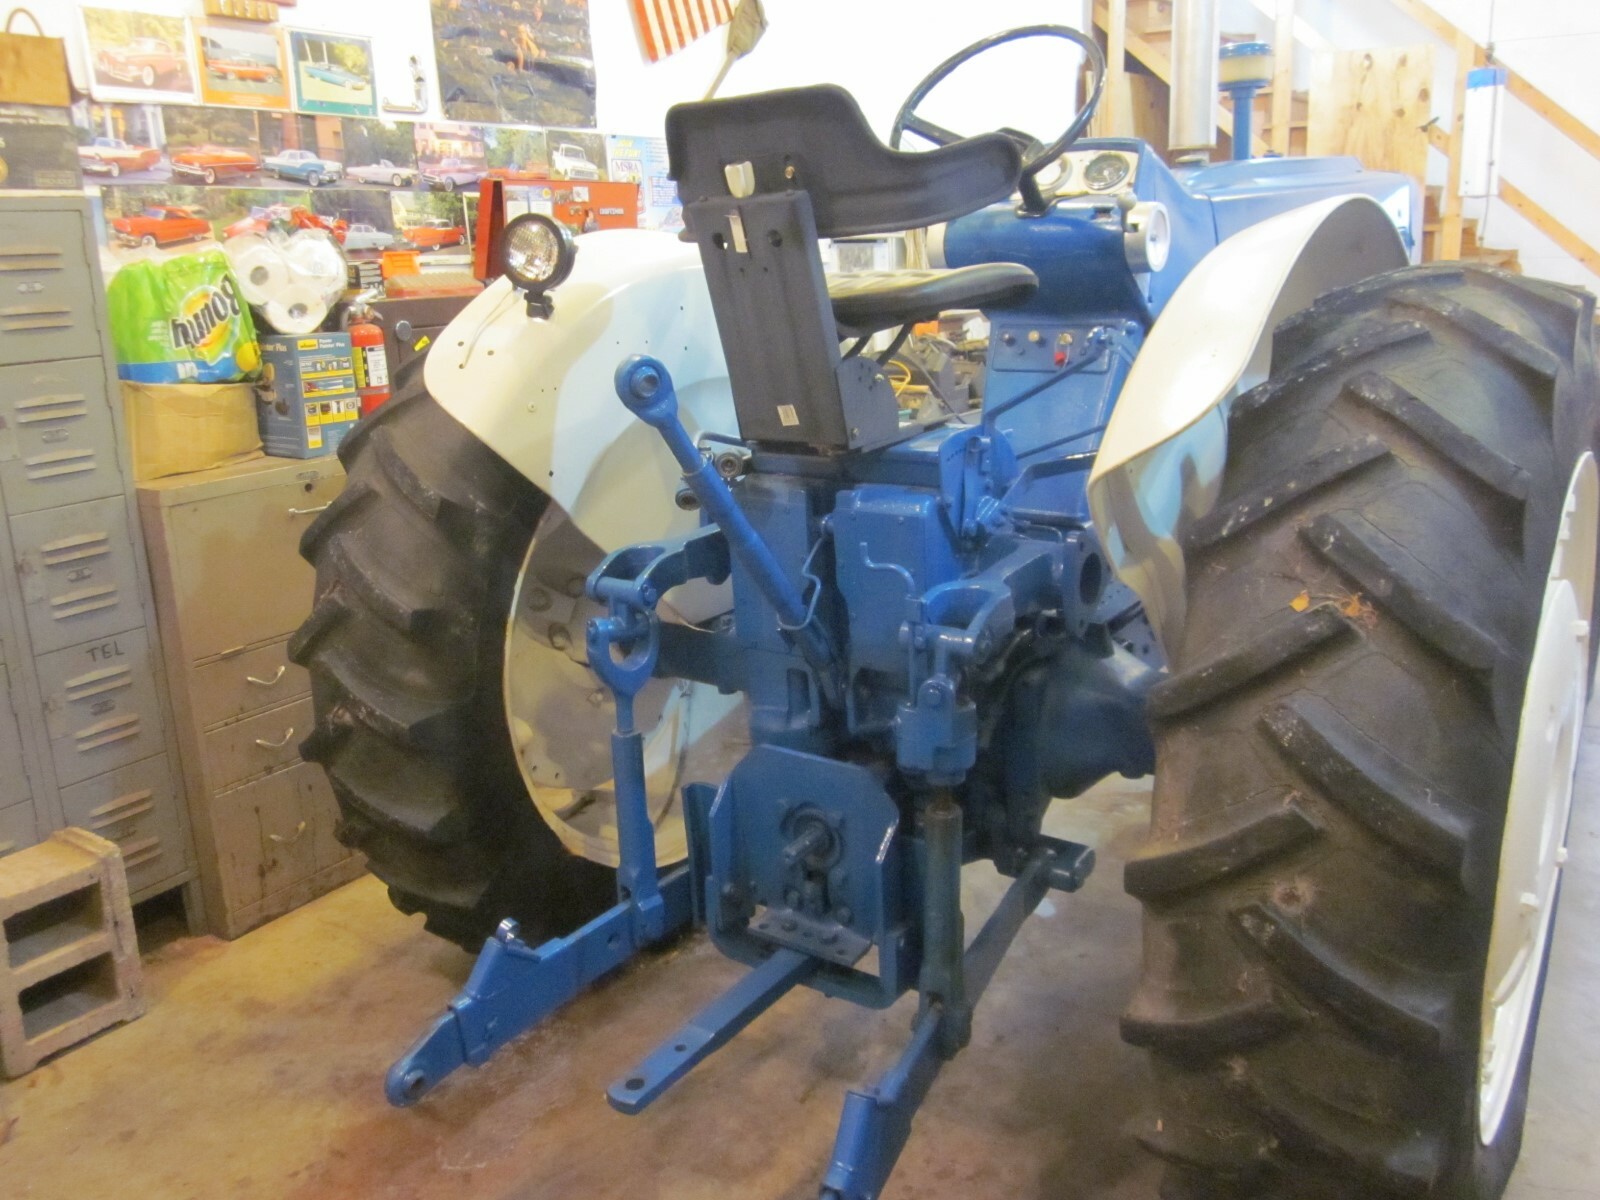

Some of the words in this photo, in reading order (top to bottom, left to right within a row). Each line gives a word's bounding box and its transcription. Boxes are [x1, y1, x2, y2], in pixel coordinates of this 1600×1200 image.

[615, 160, 640, 172] MSRA
[171, 273, 240, 349] Bounty
[85, 640, 125, 662] TEL
